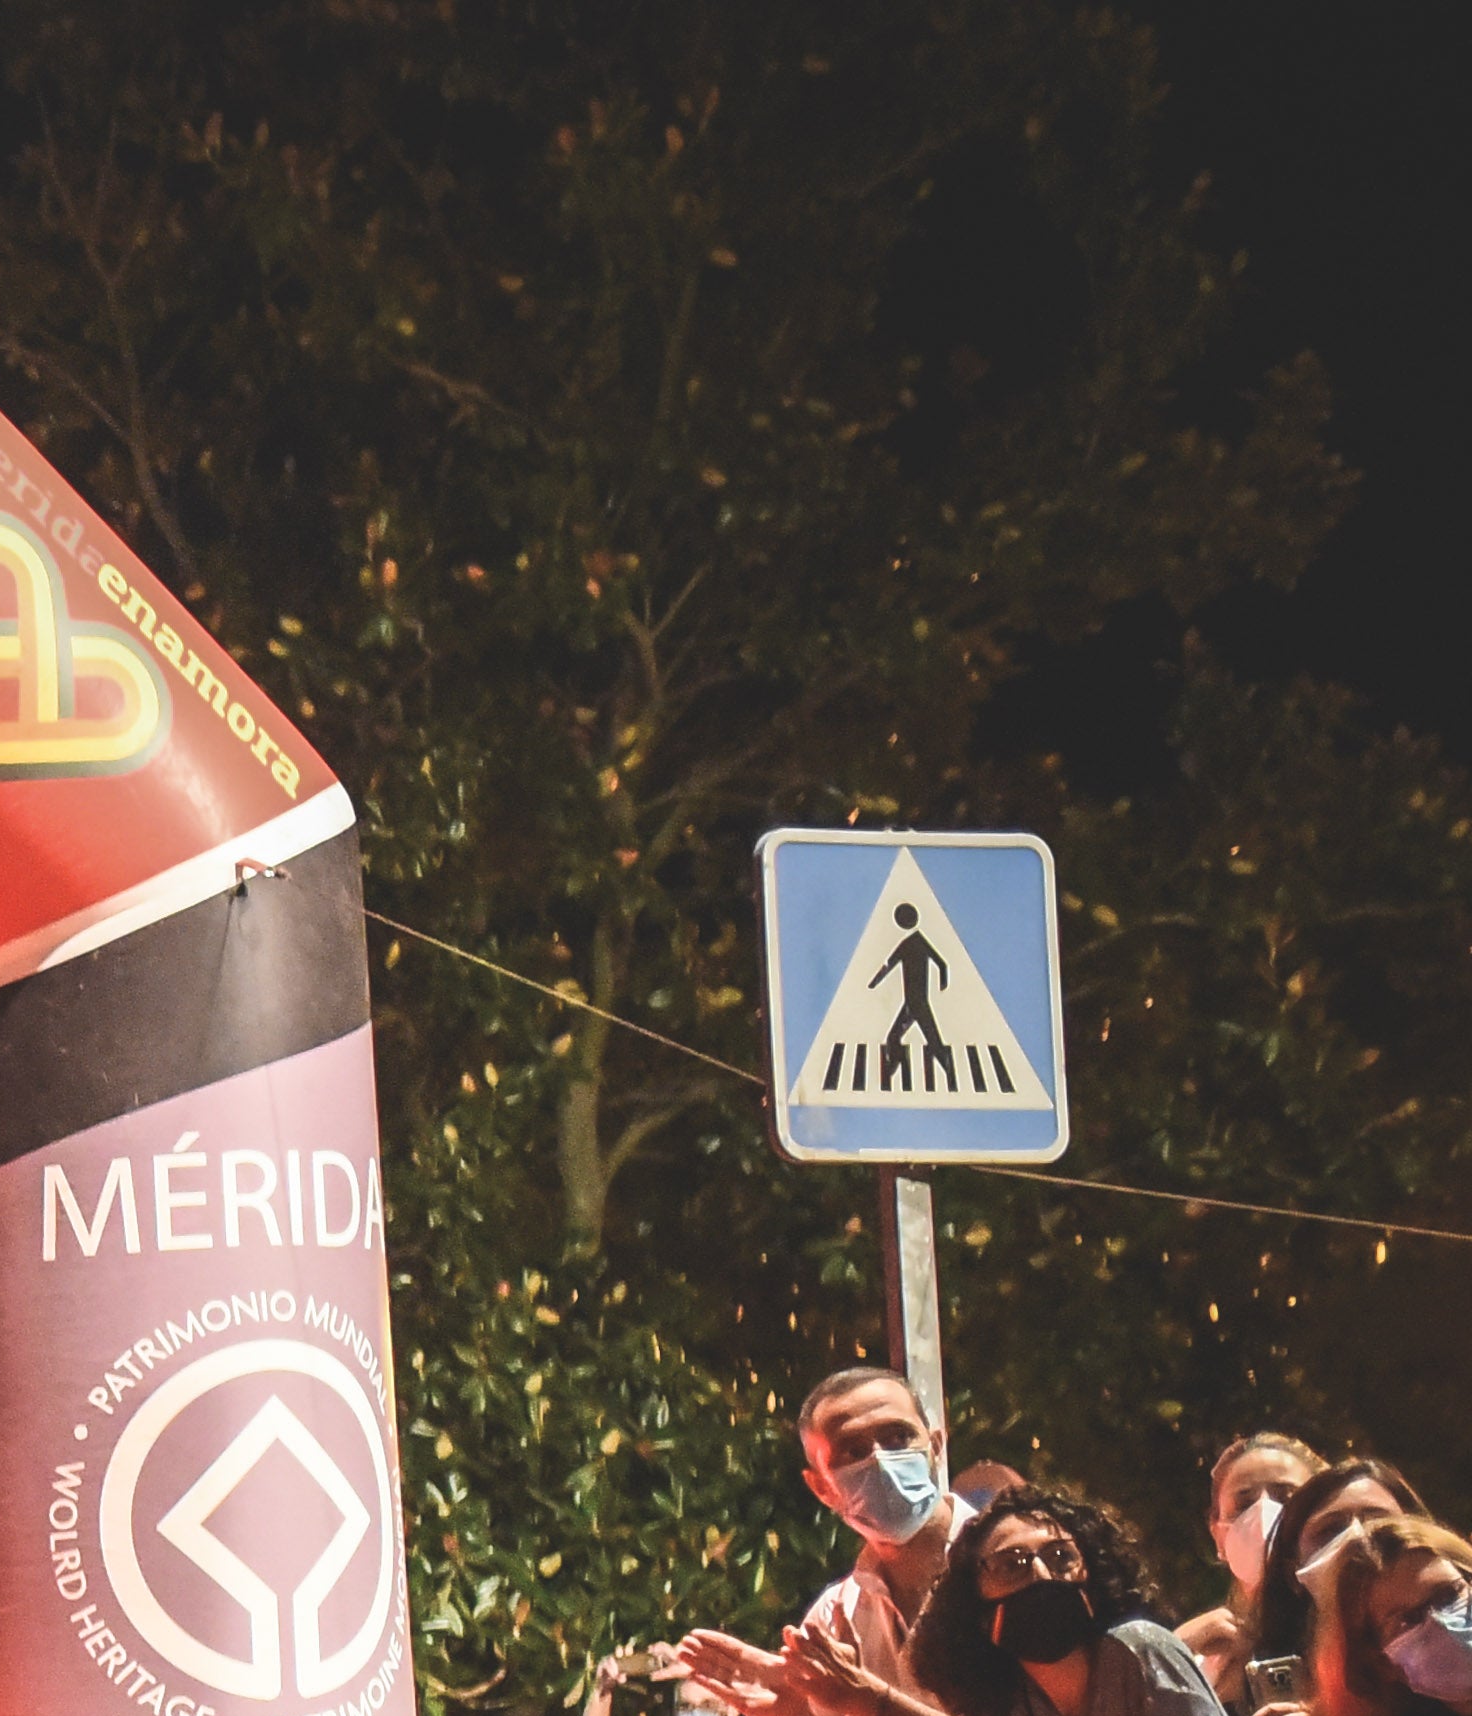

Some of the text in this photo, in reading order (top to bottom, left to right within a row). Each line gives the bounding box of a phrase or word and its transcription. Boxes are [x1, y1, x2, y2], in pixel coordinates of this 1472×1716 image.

[42, 1130, 386, 1262] MÉRIDA
[87, 1290, 389, 1417] PATRIMONIO MUNDIAL
[48, 1460, 87, 1602] WOLRD
